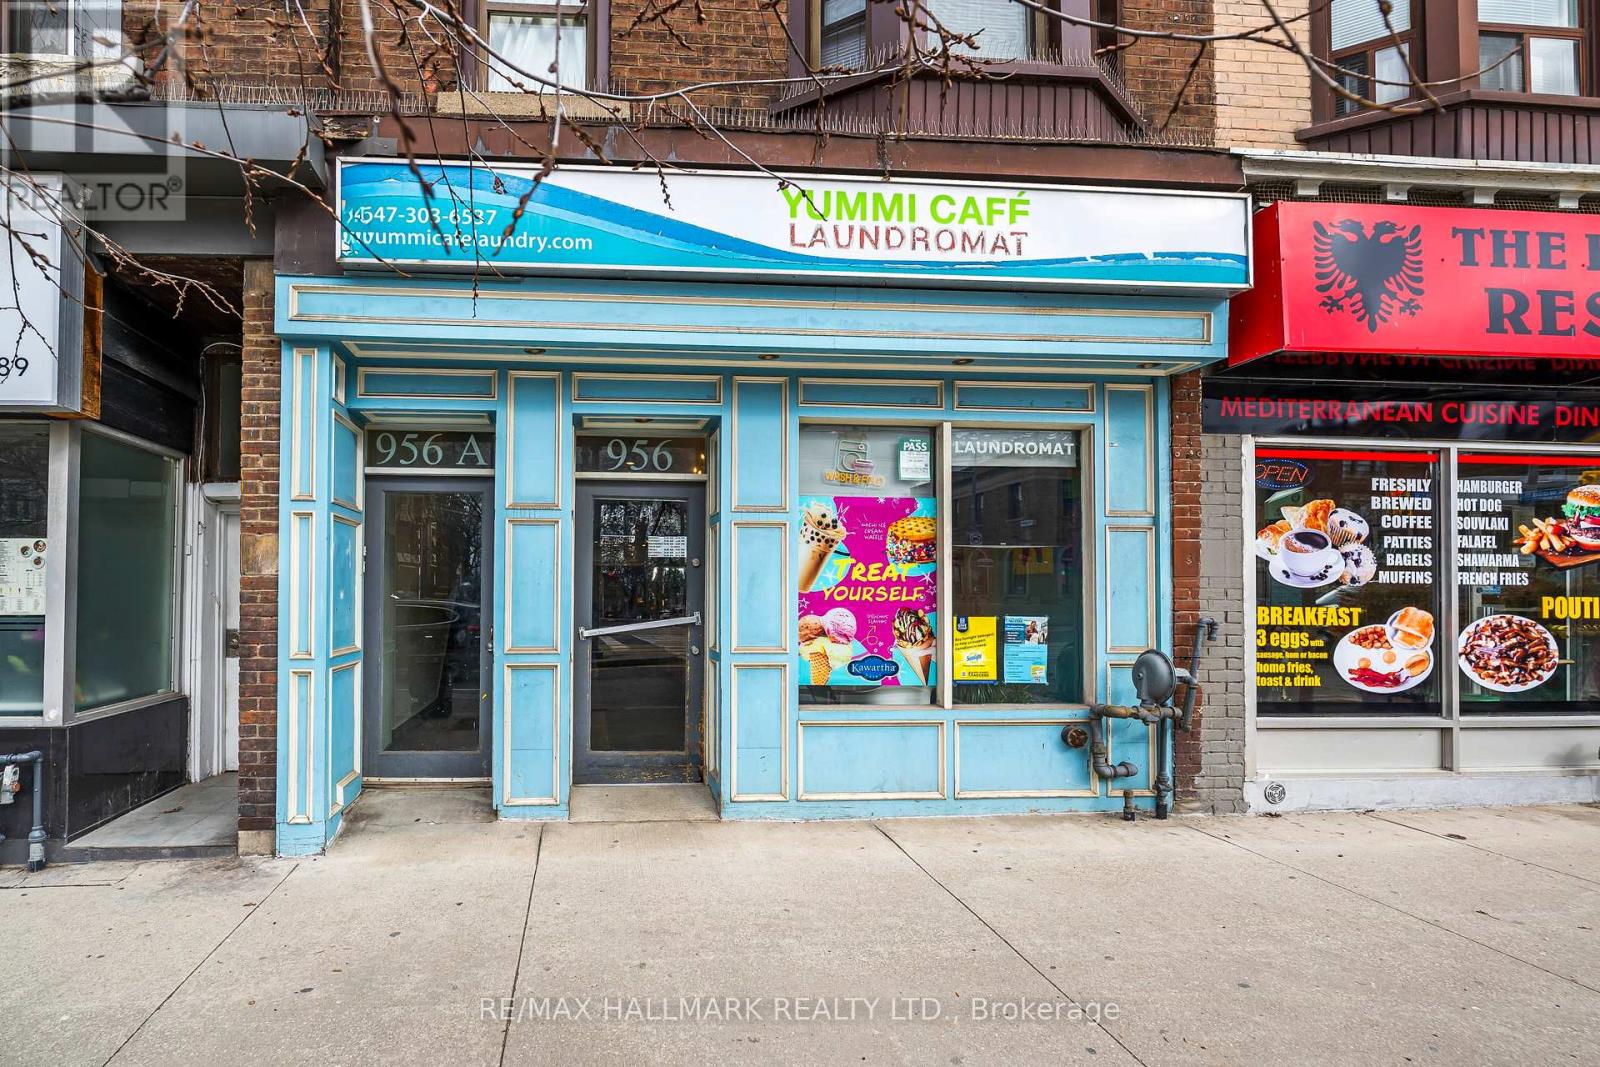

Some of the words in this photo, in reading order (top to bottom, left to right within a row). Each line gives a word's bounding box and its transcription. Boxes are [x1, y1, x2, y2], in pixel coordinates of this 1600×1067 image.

[782, 189, 916, 223] YUMMI
[930, 191, 1031, 226] CAFÉ
[789, 223, 1028, 256] LAUNDROMAT
[1452, 227, 1567, 270] THE
[1220, 397, 1433, 423] MEDITERRANEAN
[1442, 403, 1540, 426] CUISINE
[376, 432, 443, 465] 956
[456, 434, 489, 465] A
[903, 442, 928, 452] PASS
[954, 440, 1075, 456] LAUNDROMAT
[606, 439, 673, 471] 956
[1371, 478, 1432, 492] FRESHLY
[1457, 480, 1522, 494] HAMBURGER
[1371, 496, 1432, 510] BREWED
[1457, 498, 1478, 512] HOT
[1480, 499, 1502, 512] DOG
[1381, 515, 1432, 529] COFFEE
[1457, 517, 1509, 531] SOUVLAKI
[1384, 536, 1432, 549] PATTIES
[1457, 536, 1497, 549] FALAFEL
[1386, 554, 1432, 567] BAGELS
[1457, 554, 1519, 567] SHAWARMA
[833, 558, 918, 582] TREAT
[1379, 571, 1432, 584] MUFFINS
[1458, 572, 1498, 585] FRENCH
[1500, 573, 1529, 585] FRIES
[823, 586, 925, 602] YOURSELF
[1257, 606, 1362, 627] BREAKFAST
[1256, 629, 1267, 647] 3
[1270, 632, 1310, 649] eggs
[1256, 662, 1285, 673] home
[1287, 661, 1314, 675] fries,
[1256, 675, 1282, 687] toast
[1284, 677, 1292, 687] &
[1294, 675, 1321, 687] drink
